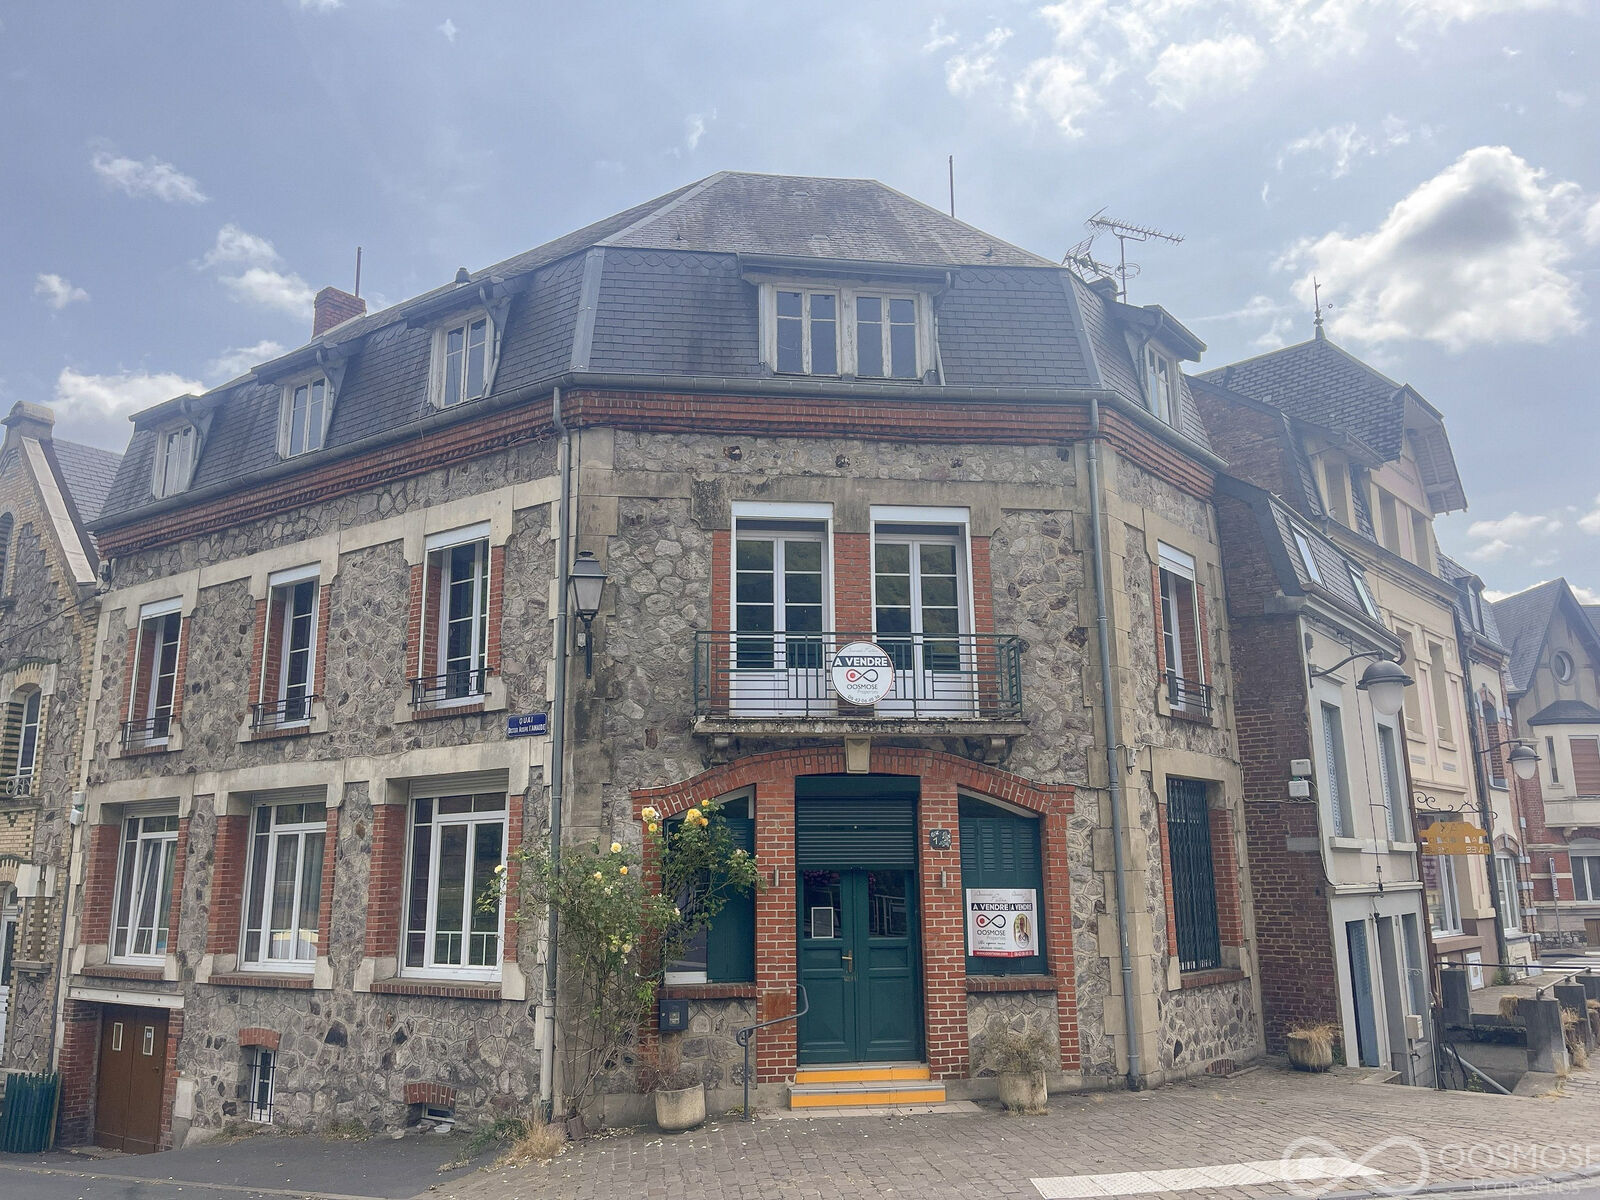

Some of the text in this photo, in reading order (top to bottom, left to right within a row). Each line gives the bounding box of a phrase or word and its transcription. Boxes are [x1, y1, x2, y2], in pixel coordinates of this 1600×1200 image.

[834, 658, 888, 666] A VENDRE
[519, 716, 533, 724] QUAI
